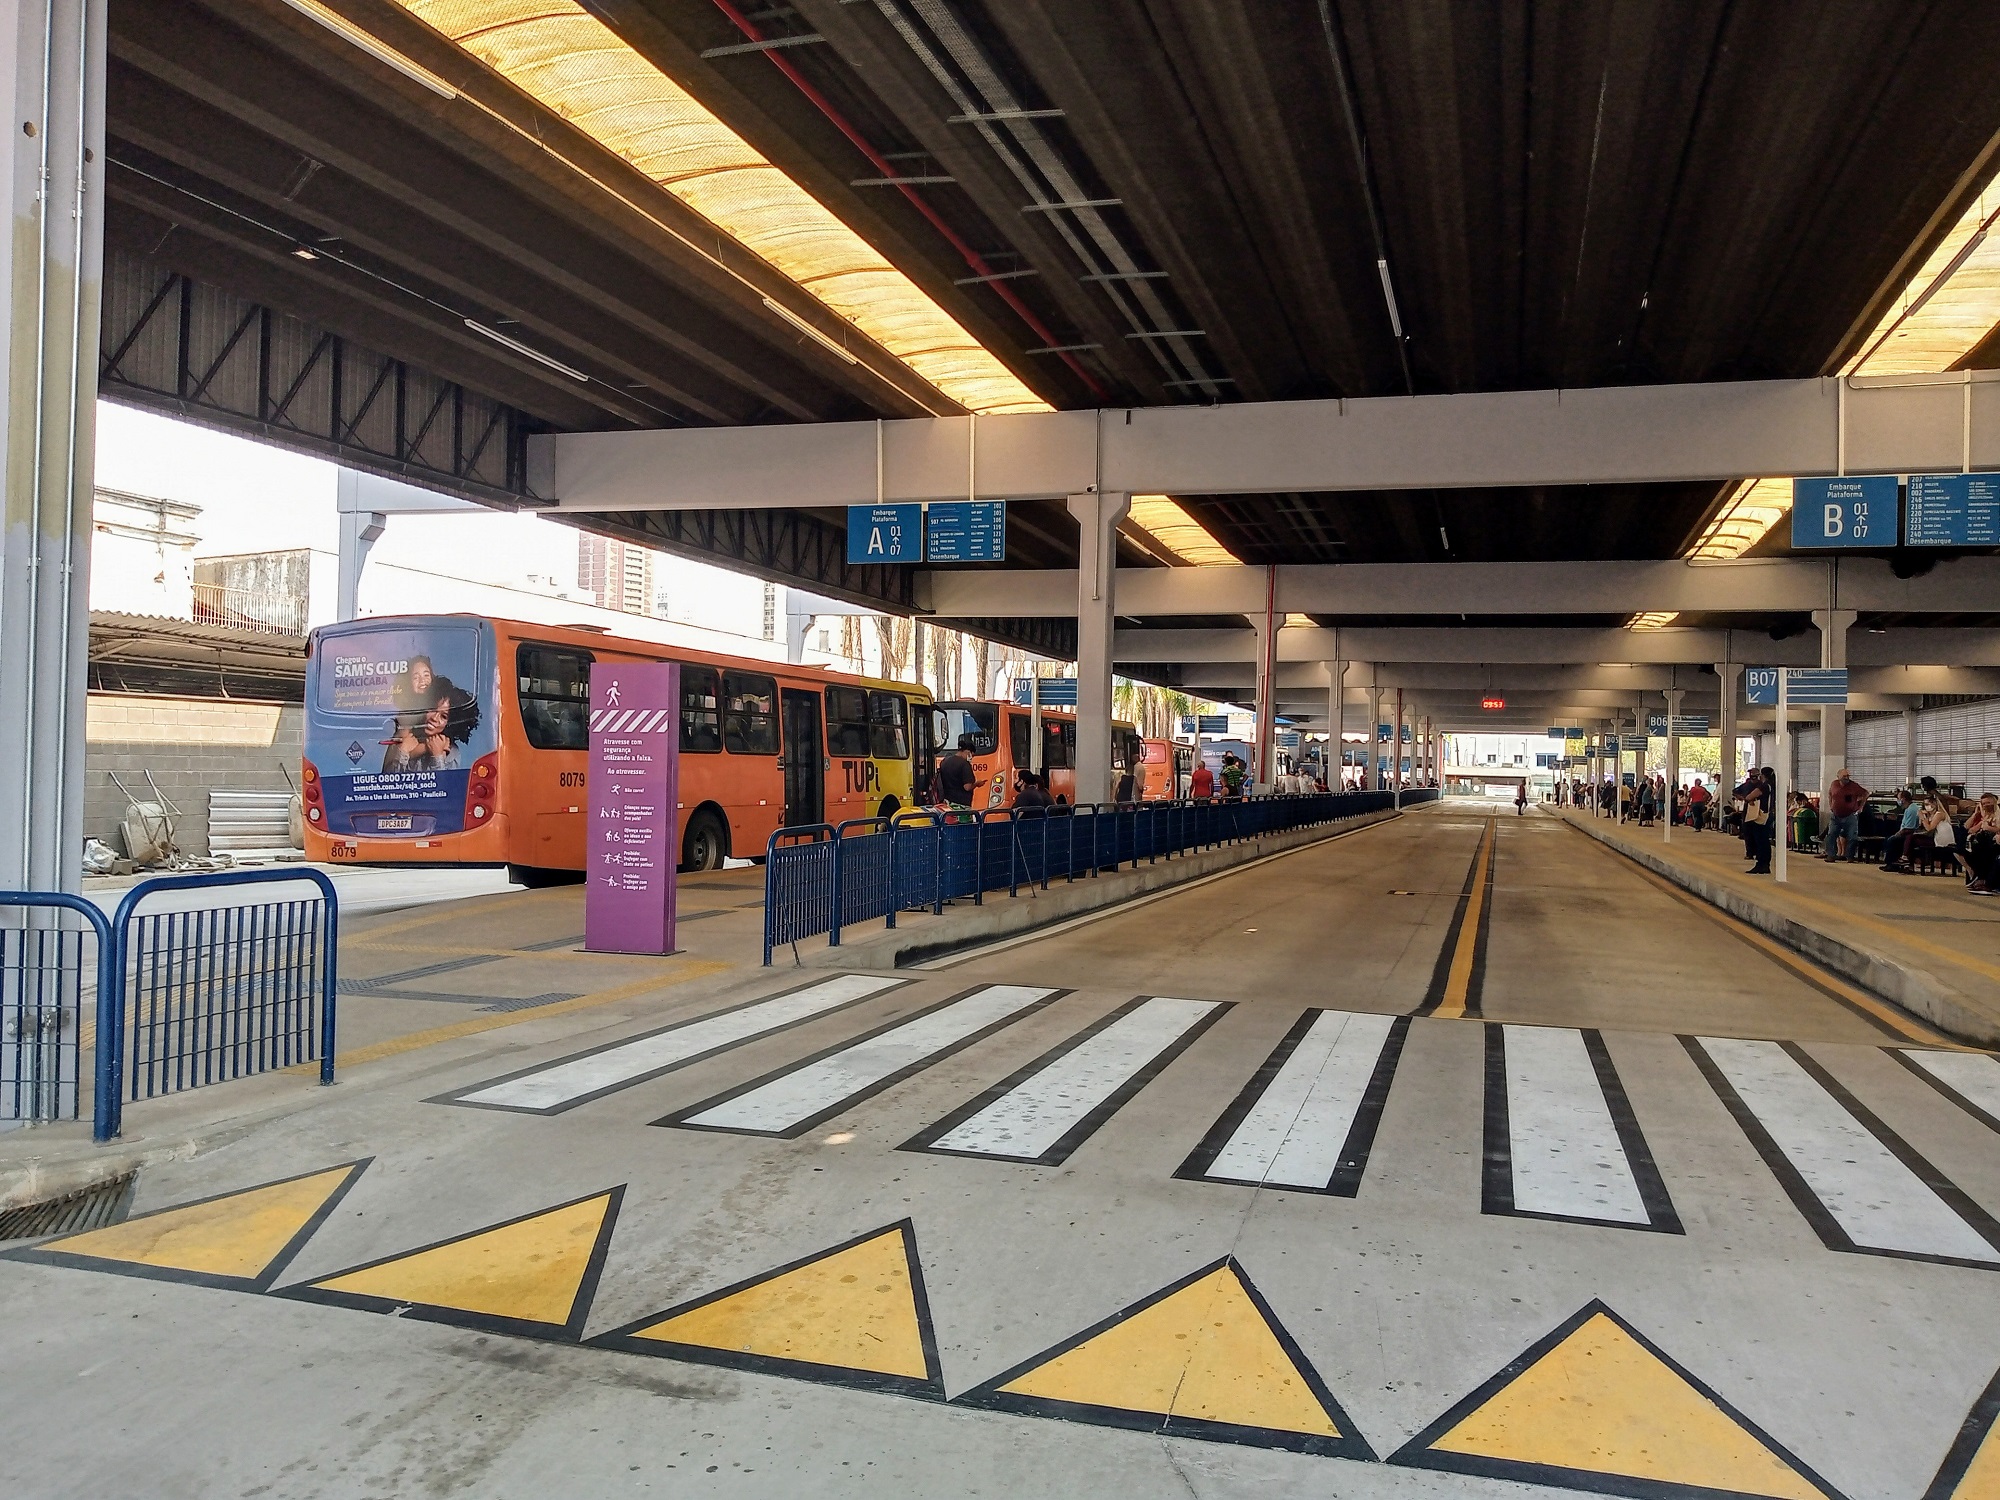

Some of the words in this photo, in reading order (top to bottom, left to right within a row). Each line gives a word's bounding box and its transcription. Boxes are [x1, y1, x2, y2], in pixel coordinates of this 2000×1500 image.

[1854, 503, 1868, 515] 01
[1824, 504, 1843, 537] B
[890, 526, 901, 536] 01
[1854, 526, 1868, 537] 07
[868, 527, 883, 554] A
[890, 545, 901, 555] 07
[335, 663, 374, 677] SAM'S
[376, 661, 408, 674] CLUB
[335, 677, 388, 688] PIRACICABA
[1750, 672, 1776, 686] B07
[1014, 680, 1032, 691] A07
[1651, 717, 1667, 726] B06
[353, 775, 377, 784] LIGUE:
[378, 774, 400, 783] 0800
[402, 773, 416, 781] 727
[417, 772, 435, 780] 7014
[560, 772, 585, 787] 8079
[842, 761, 880, 793] TUPi
[332, 847, 356, 857] 8079
